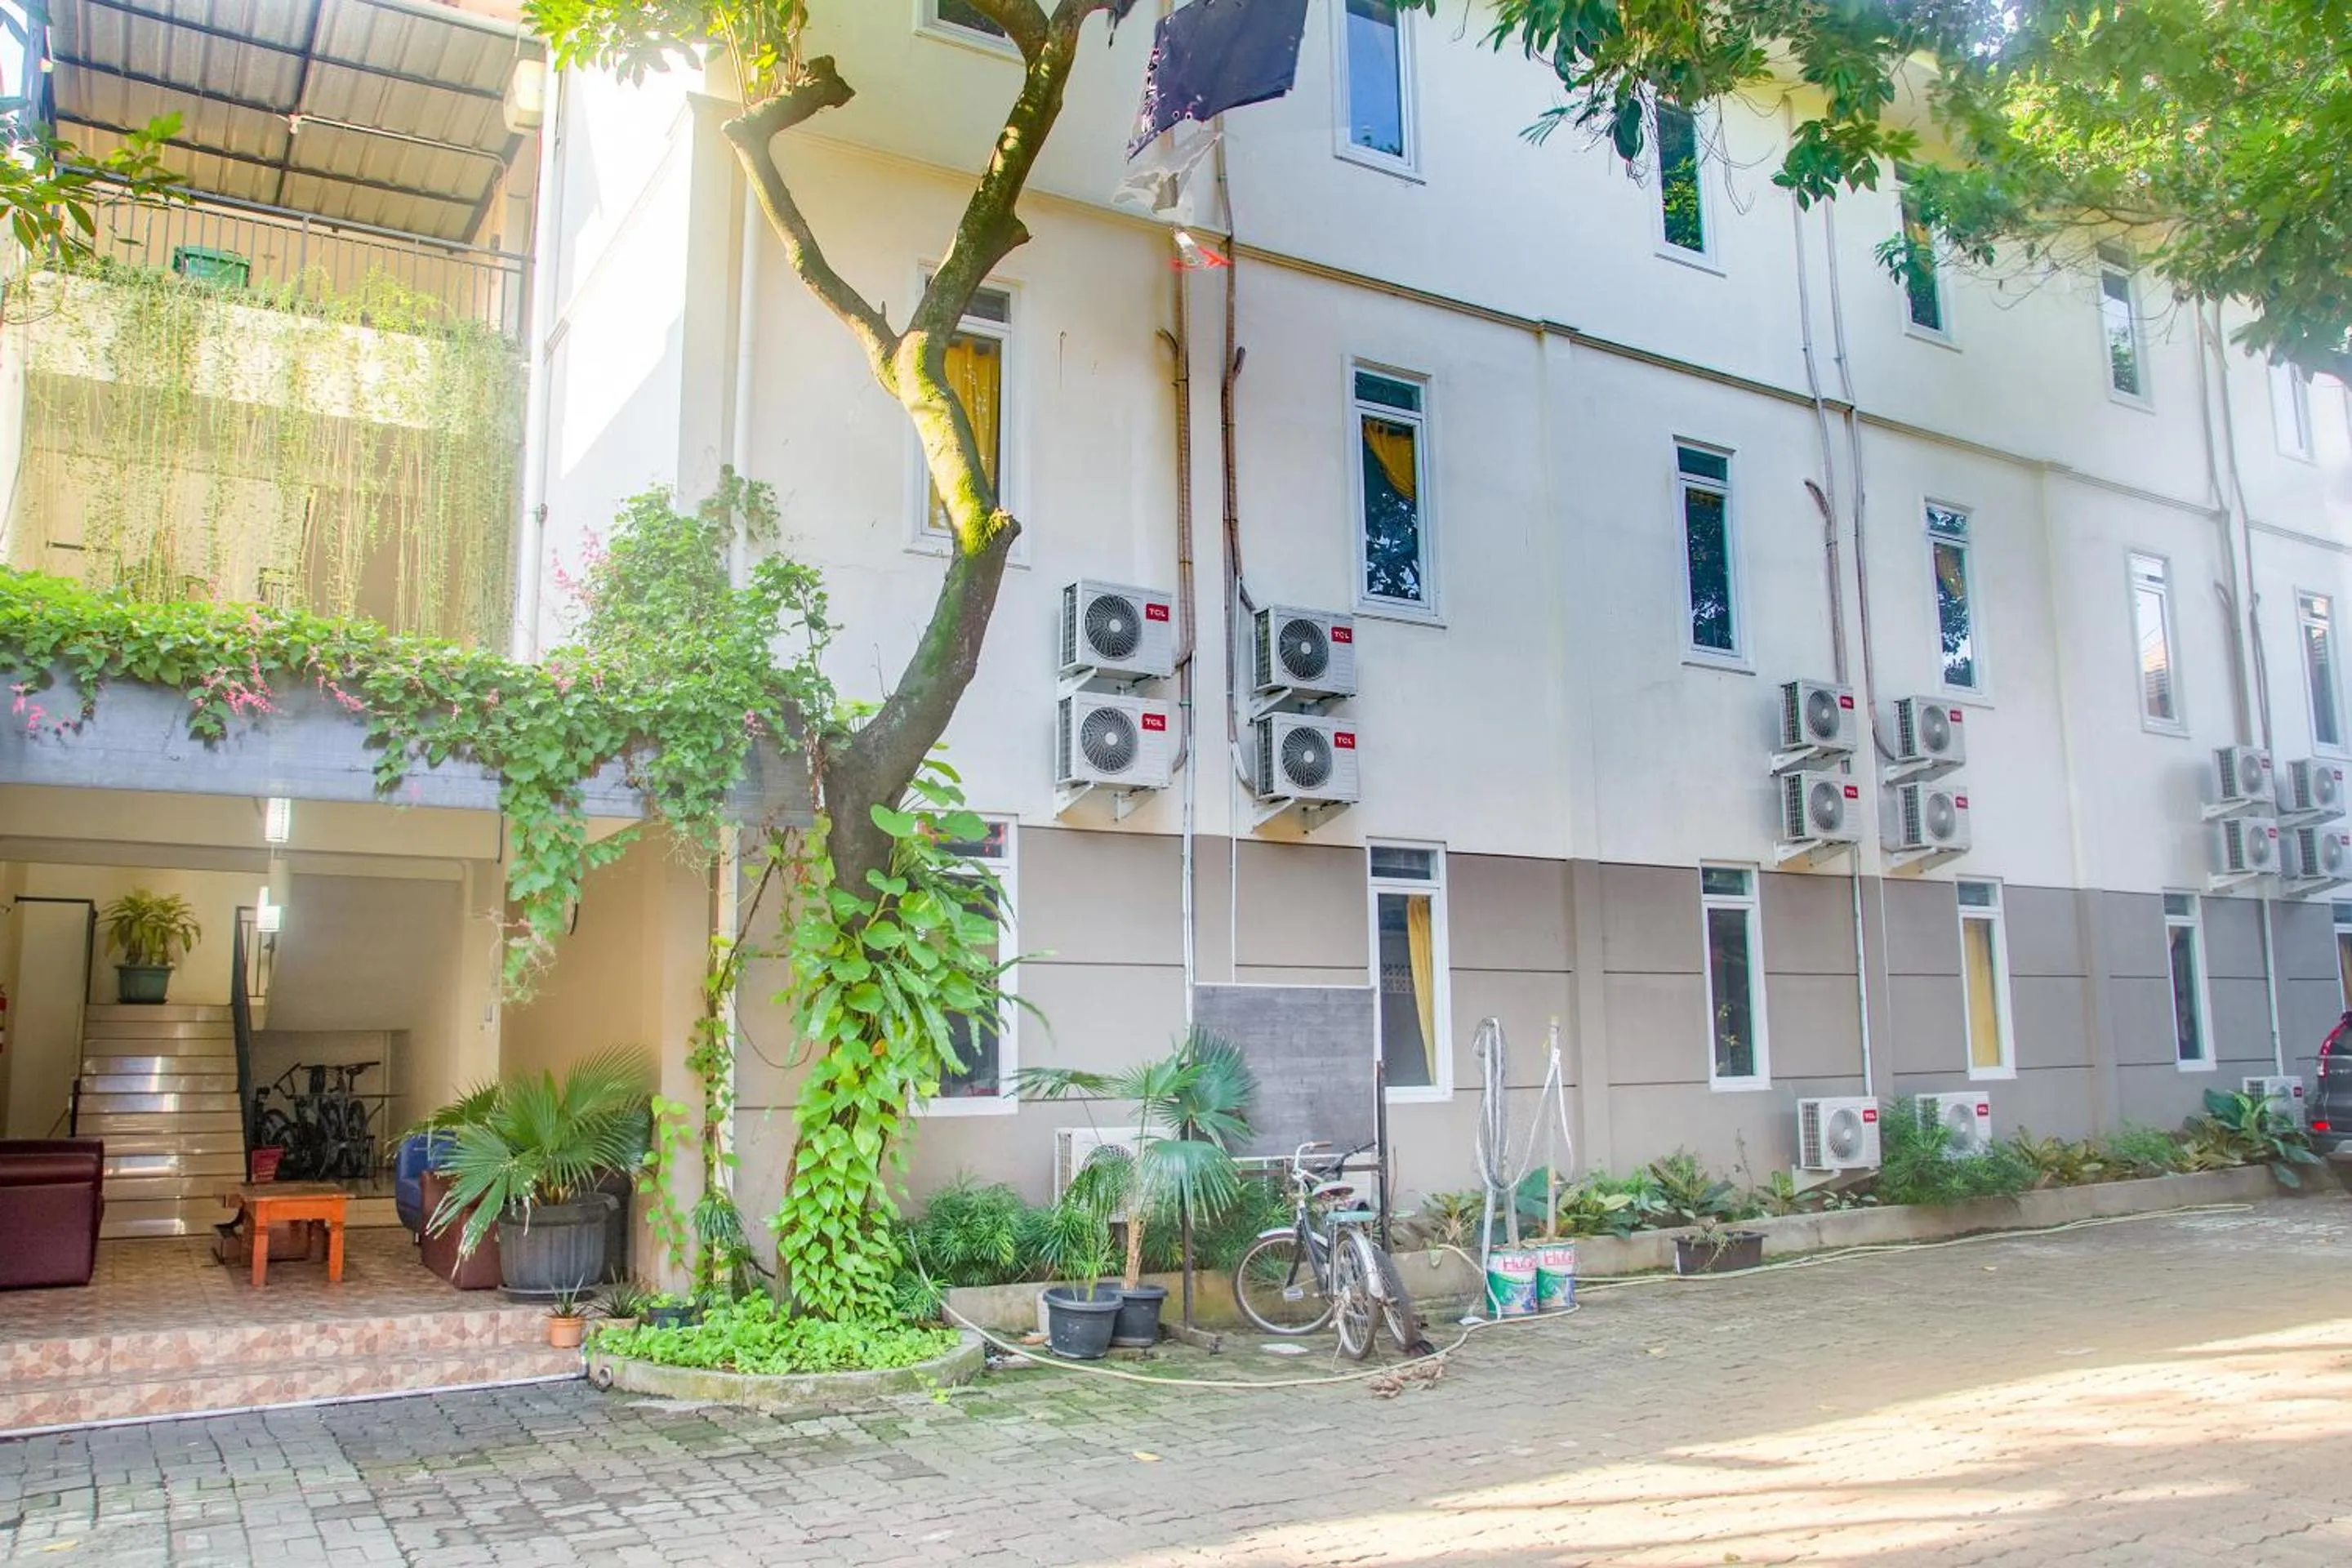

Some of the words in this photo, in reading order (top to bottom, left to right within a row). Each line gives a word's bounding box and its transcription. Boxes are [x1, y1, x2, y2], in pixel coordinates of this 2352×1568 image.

[1148, 608, 1166, 617] TCL
[1145, 718, 1164, 727] TCL
[1337, 736, 1352, 744] TCL
